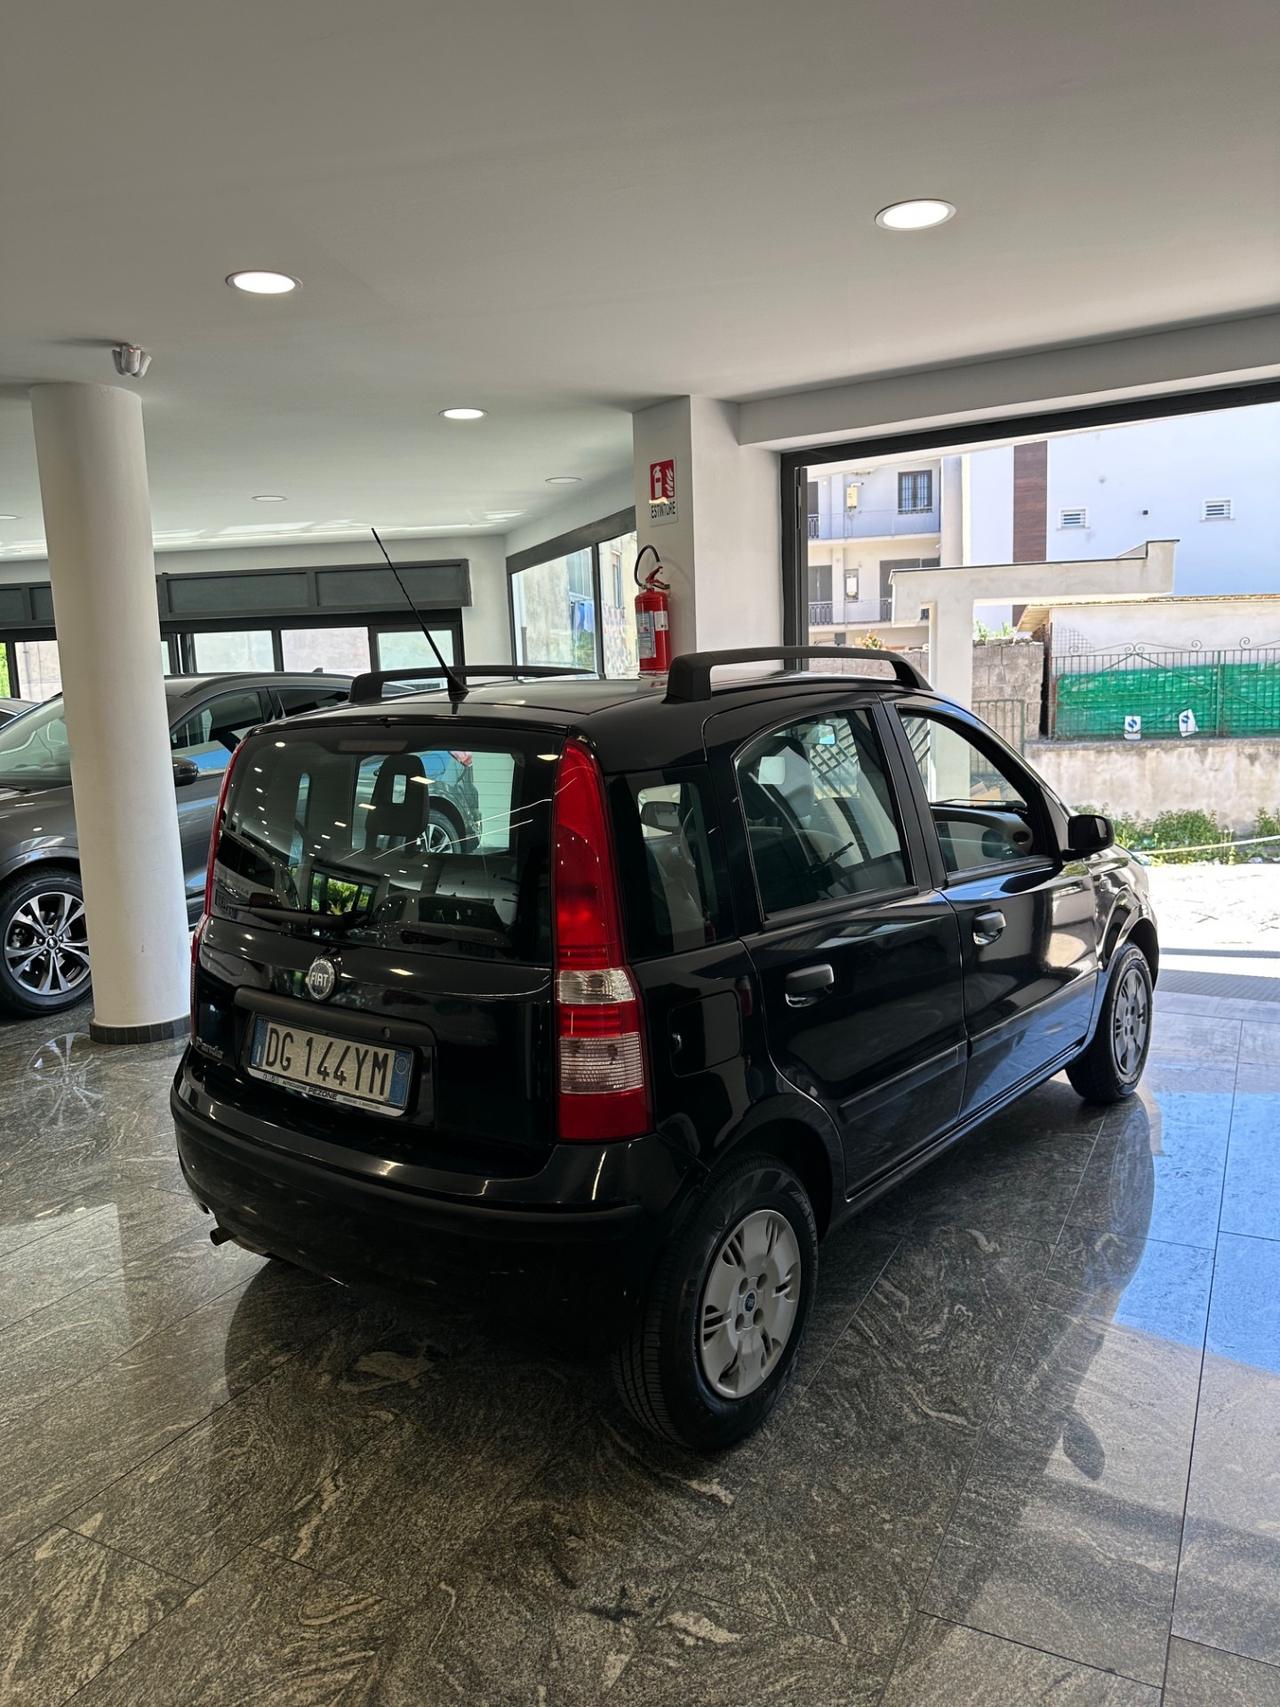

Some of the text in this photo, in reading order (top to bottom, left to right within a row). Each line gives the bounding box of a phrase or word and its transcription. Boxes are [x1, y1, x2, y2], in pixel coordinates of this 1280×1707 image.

[310, 971, 329, 987] FIAT
[265, 1027, 389, 1097] DG 144YM
